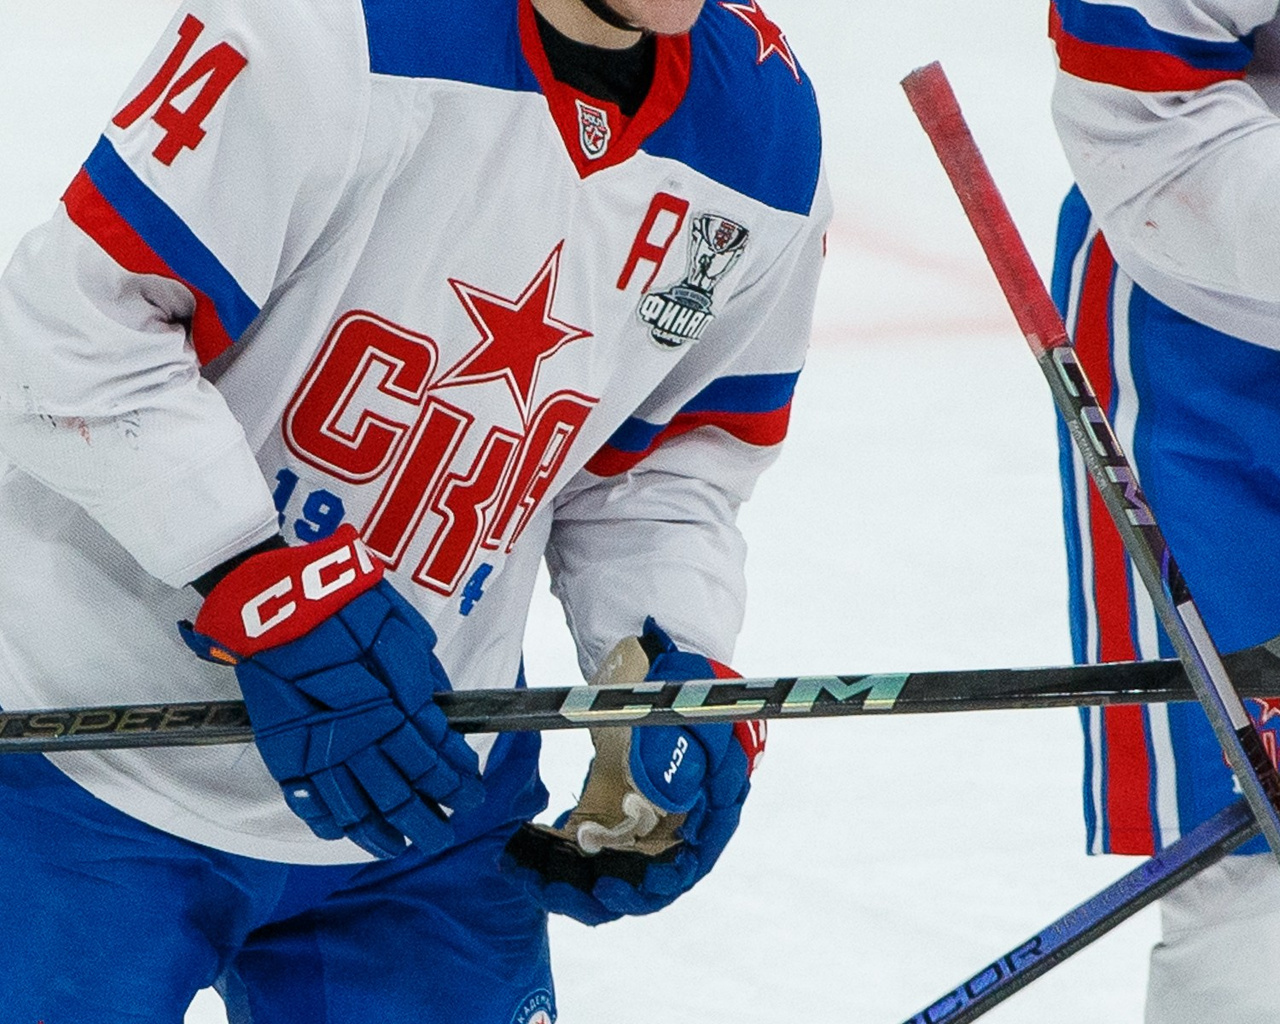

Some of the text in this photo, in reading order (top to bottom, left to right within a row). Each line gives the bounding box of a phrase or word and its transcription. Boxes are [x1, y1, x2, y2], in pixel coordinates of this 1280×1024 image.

[112, 13, 248, 166] 14
[641, 297, 715, 339] ФИНАЛ
[282, 309, 600, 597] СКА
[1053, 346, 1156, 525] CCM
[274, 468, 345, 543] 19
[559, 673, 911, 722] CCM
[664, 736, 688, 784] CCM
[900, 935, 1044, 1024] COR
